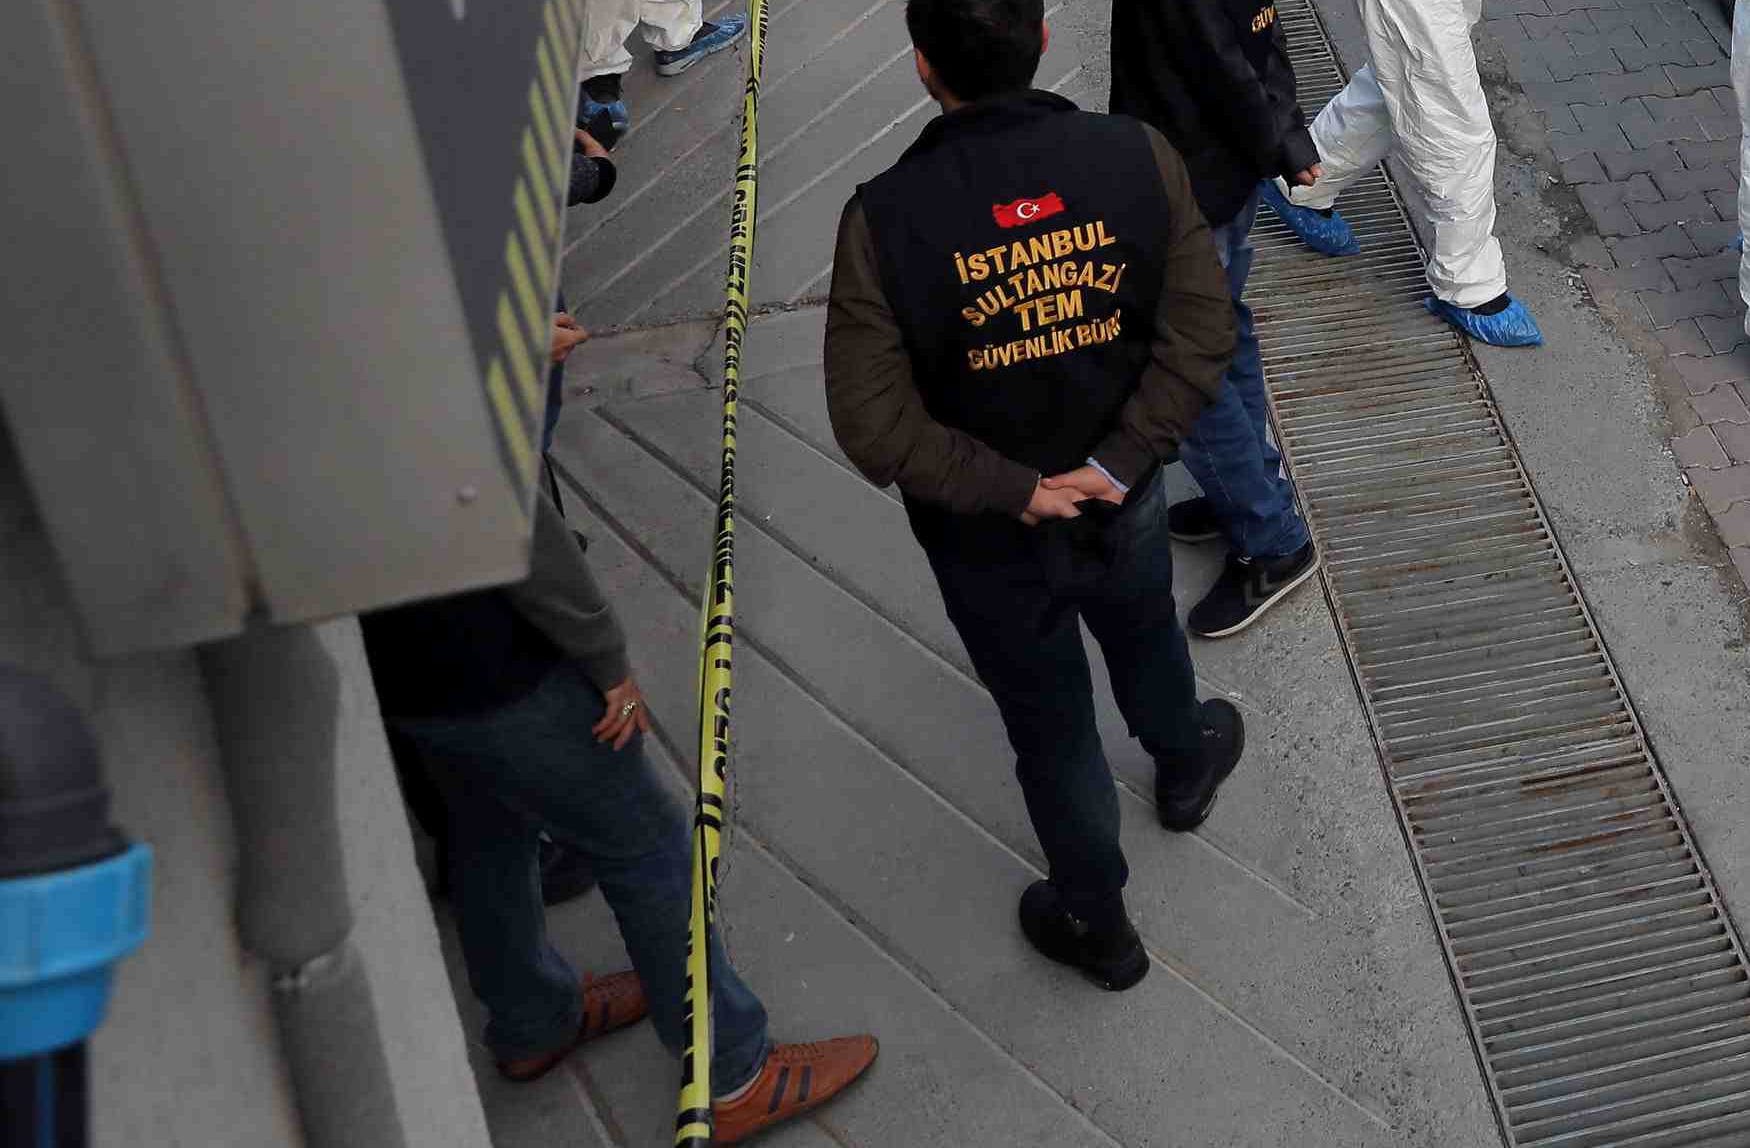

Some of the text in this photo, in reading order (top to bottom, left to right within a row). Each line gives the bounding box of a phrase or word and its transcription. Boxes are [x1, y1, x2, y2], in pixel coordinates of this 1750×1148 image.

[953, 220, 1117, 284] İSTANBUL
[961, 263, 1127, 327] SULTANGAZİ
[1014, 289, 1084, 332] TEM
[967, 326, 1074, 370] GÜVENLİK
